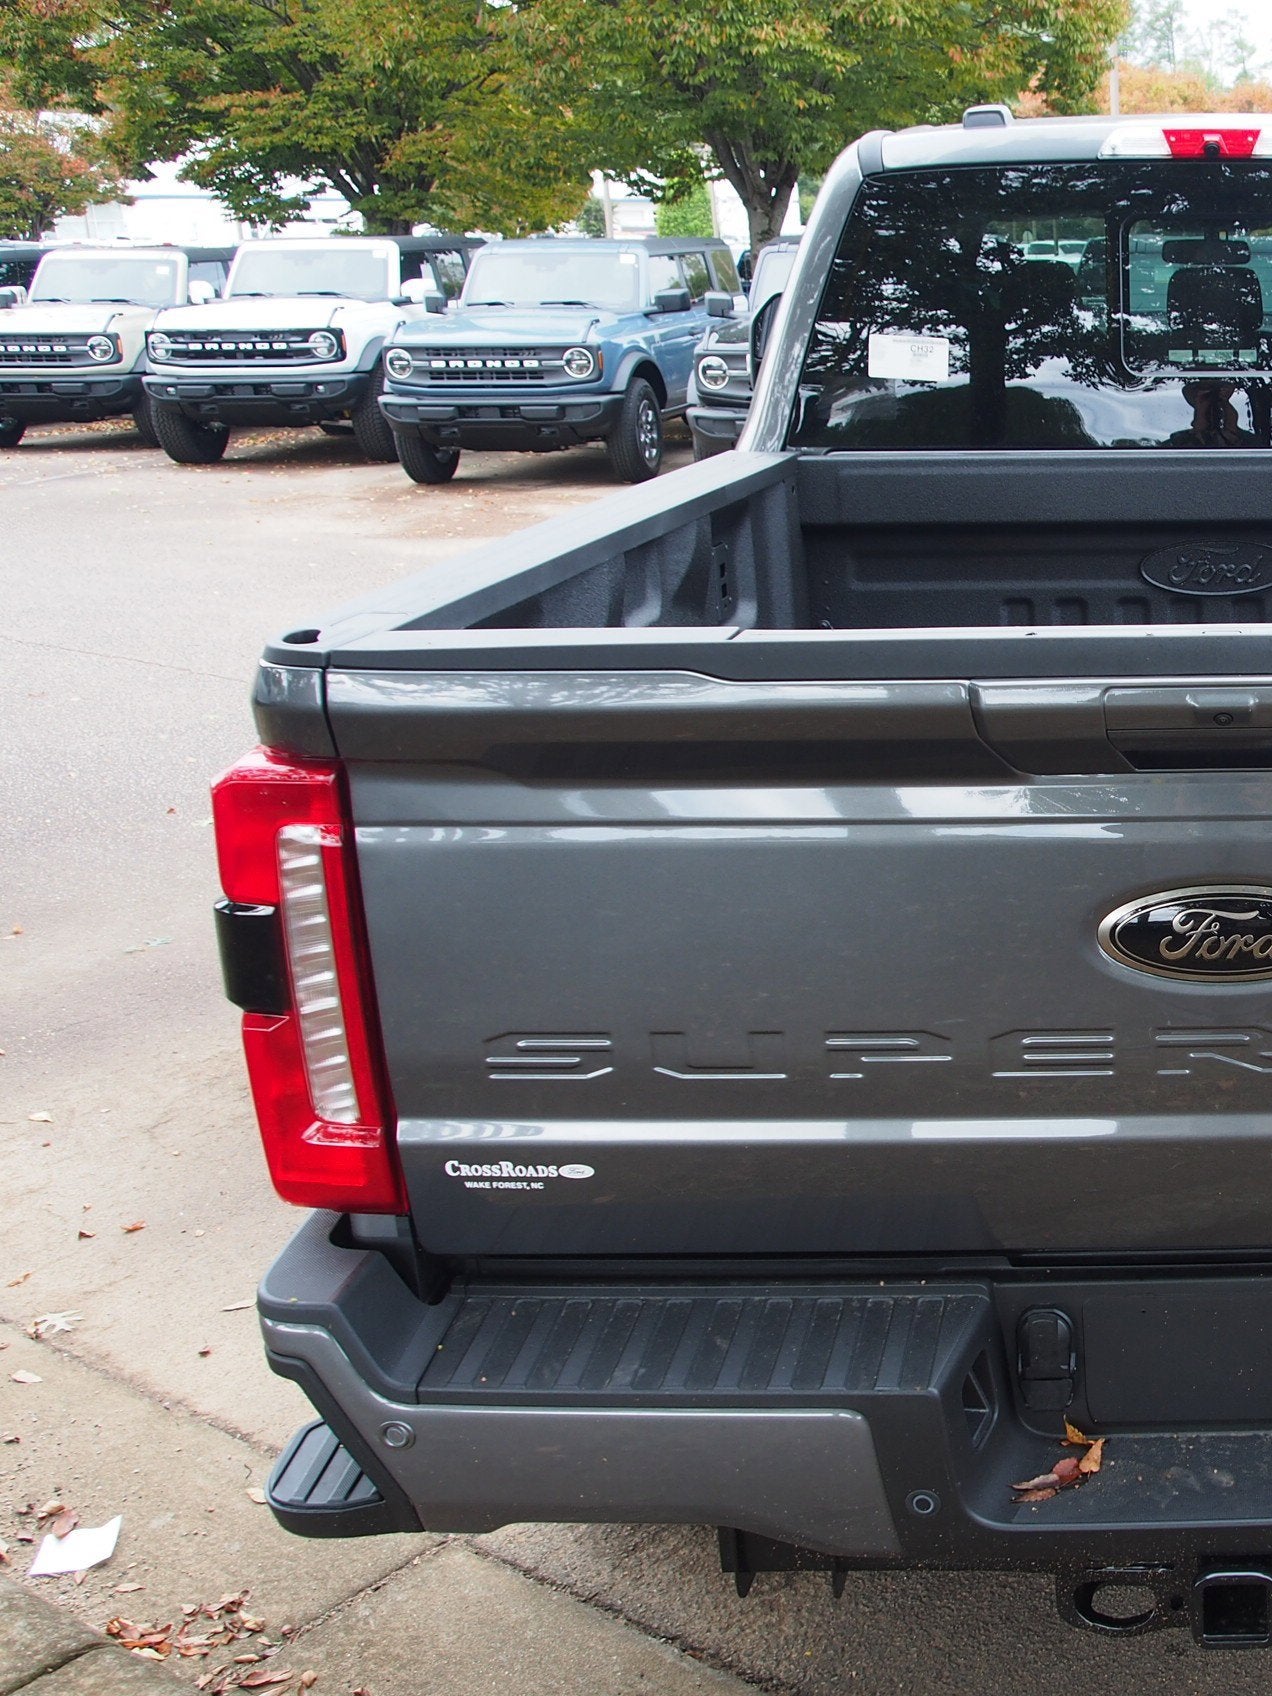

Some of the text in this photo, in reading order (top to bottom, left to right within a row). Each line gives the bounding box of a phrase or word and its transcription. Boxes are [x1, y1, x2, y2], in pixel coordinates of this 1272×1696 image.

[188, 342, 288, 351] BRONCO
[430, 360, 539, 368] BRONCO
[1168, 546, 1264, 586] Ford
[464, 1181, 492, 1189] WAKE
[492, 1181, 530, 1190] FOREST,
